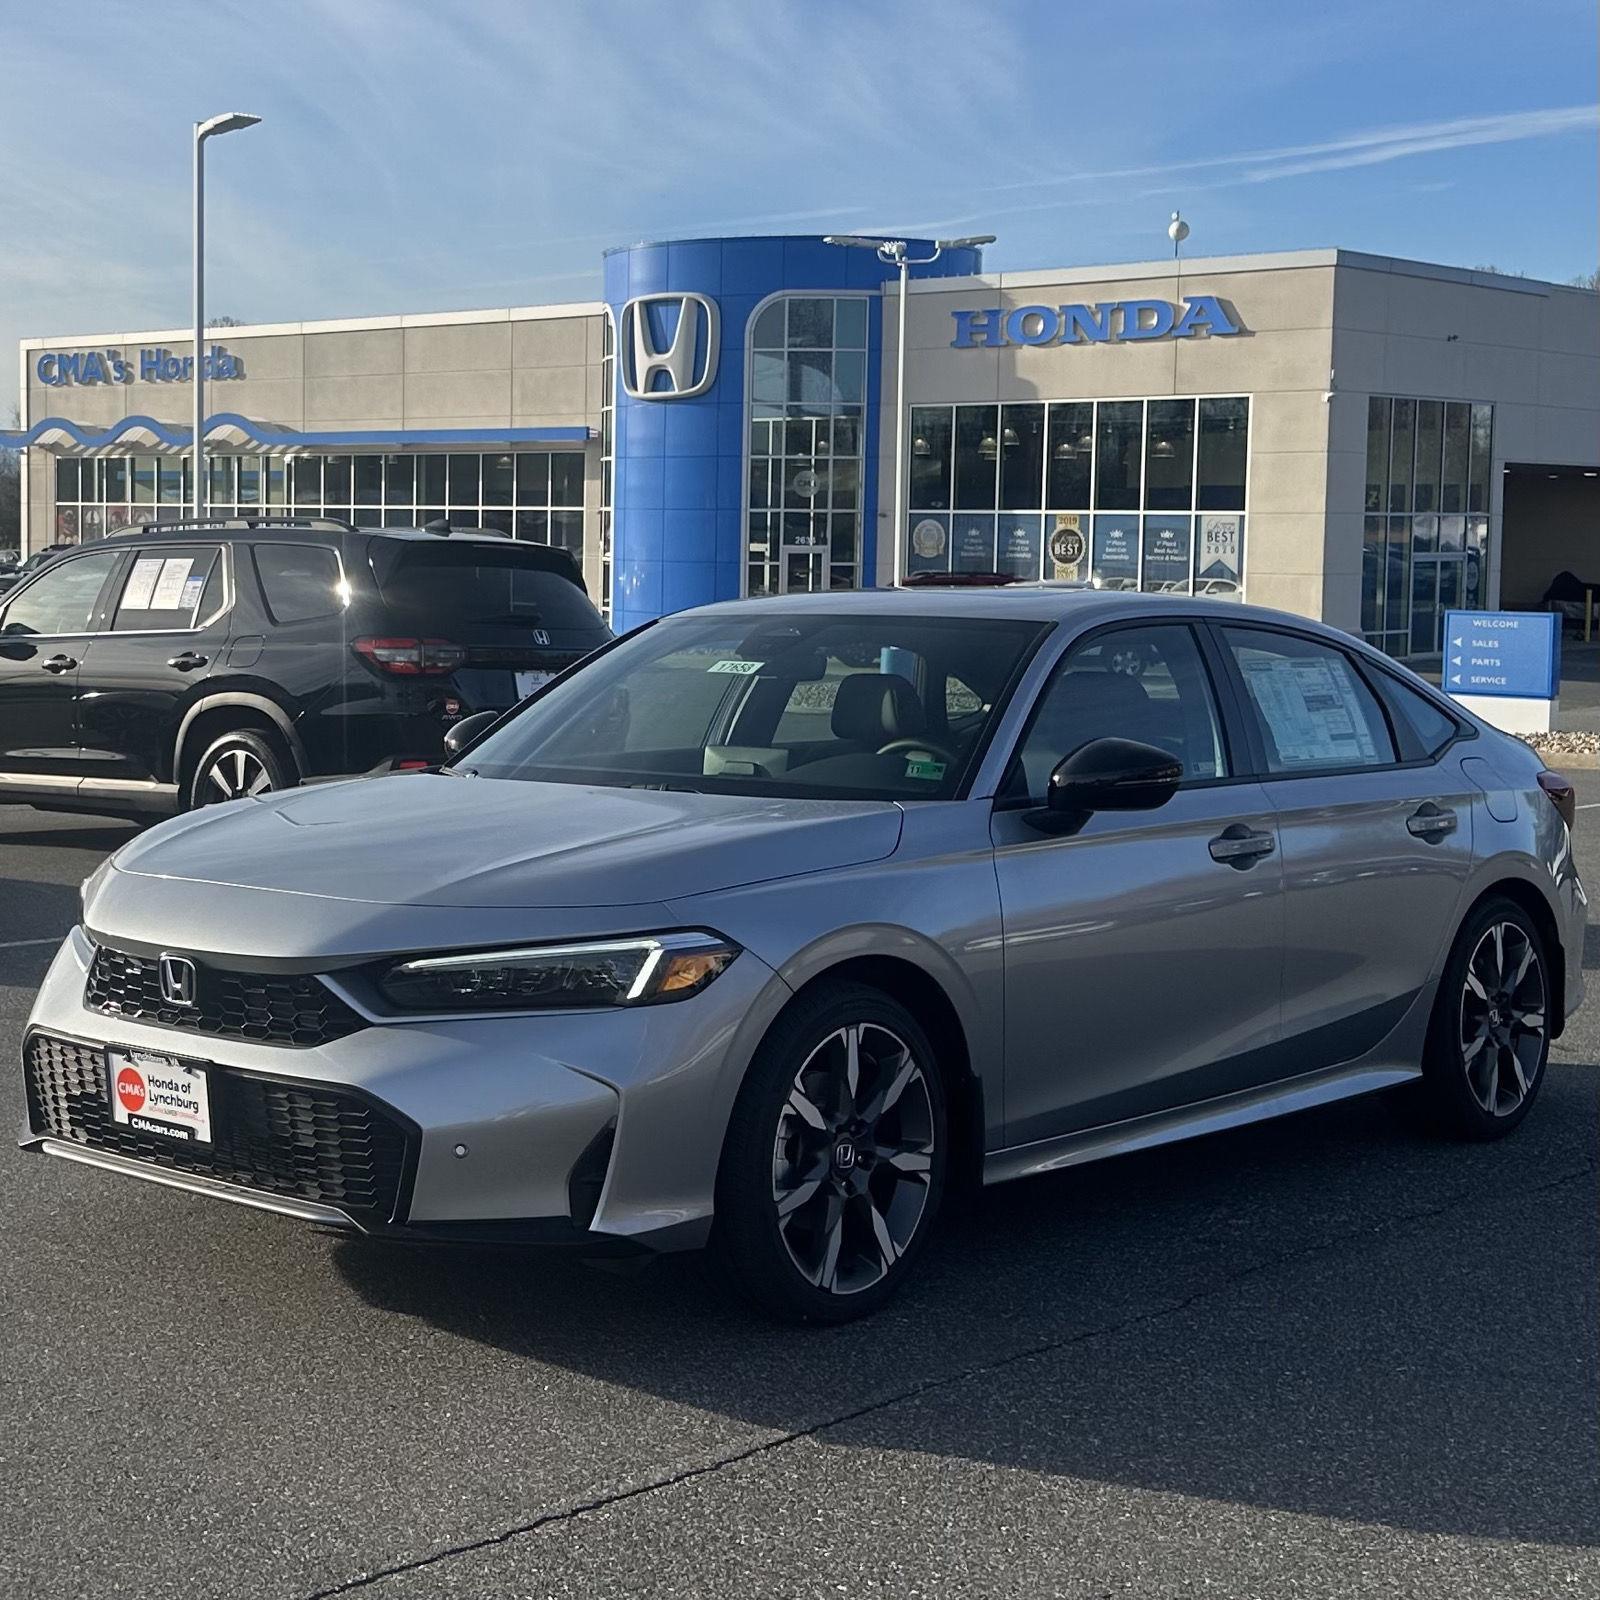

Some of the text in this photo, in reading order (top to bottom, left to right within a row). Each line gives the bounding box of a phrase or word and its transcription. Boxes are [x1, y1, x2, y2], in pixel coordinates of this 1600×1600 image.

[951, 296, 1240, 348] HONDA
[38, 345, 238, 385] CMA's Honda
[1058, 516, 1078, 525] 2019
[1207, 531, 1235, 543] BEST
[1054, 543, 1079, 555] BEST
[1206, 546, 1235, 554] 2020
[1472, 619, 1519, 628] WELCOME
[1471, 639, 1499, 648] SALES
[1471, 658, 1501, 667] PARTS
[1470, 676, 1507, 685] SERVICE
[118, 1082, 145, 1097] CMA's
[148, 1075, 192, 1094] Honda of
[149, 1089, 199, 1114] Lynchburg
[131, 1117, 189, 1140] CMAcars.com
